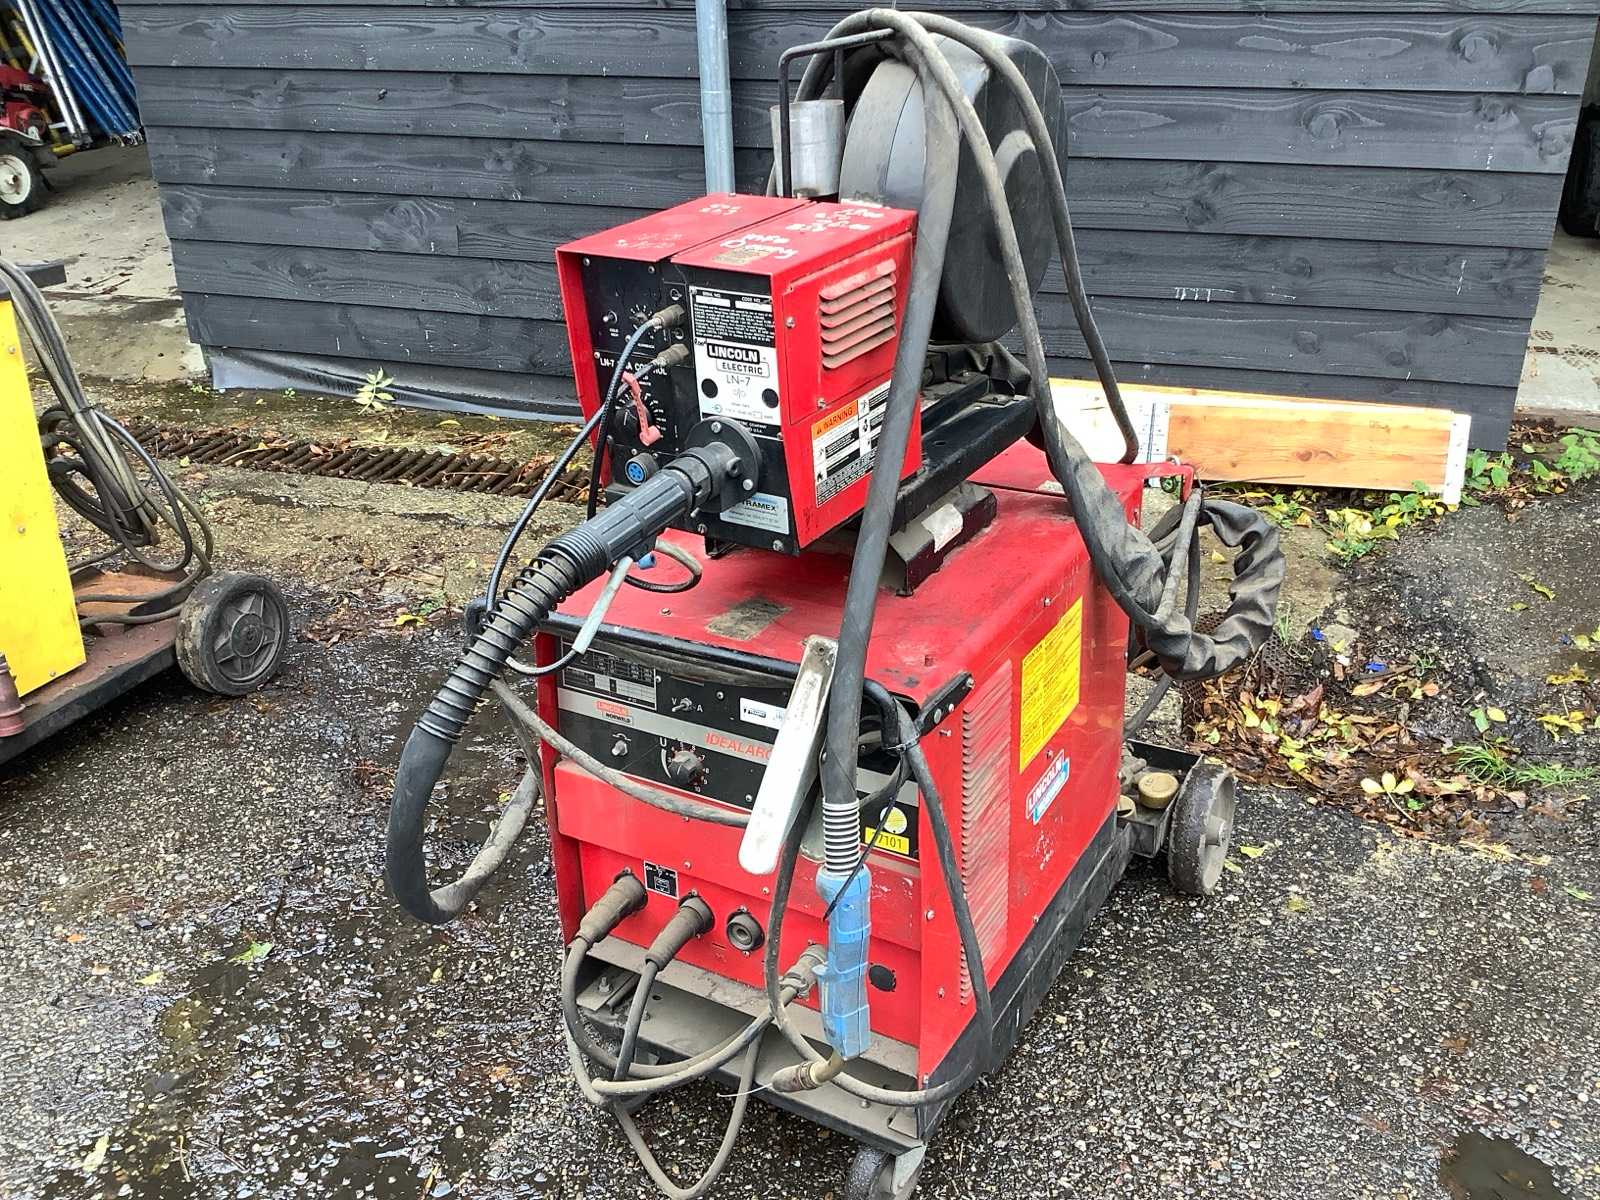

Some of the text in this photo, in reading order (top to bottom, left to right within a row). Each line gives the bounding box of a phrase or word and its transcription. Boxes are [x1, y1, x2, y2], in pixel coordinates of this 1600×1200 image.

[708, 345, 758, 363] LINCOLN
[722, 362, 763, 375] ELECTRIC
[726, 374, 751, 386] LN-7
[823, 407, 853, 429] WARNING
[742, 500, 777, 512] TRAMEX
[671, 697, 703, 713] V A
[660, 737, 667, 747] U
[1028, 760, 1062, 811] LINCOLN
